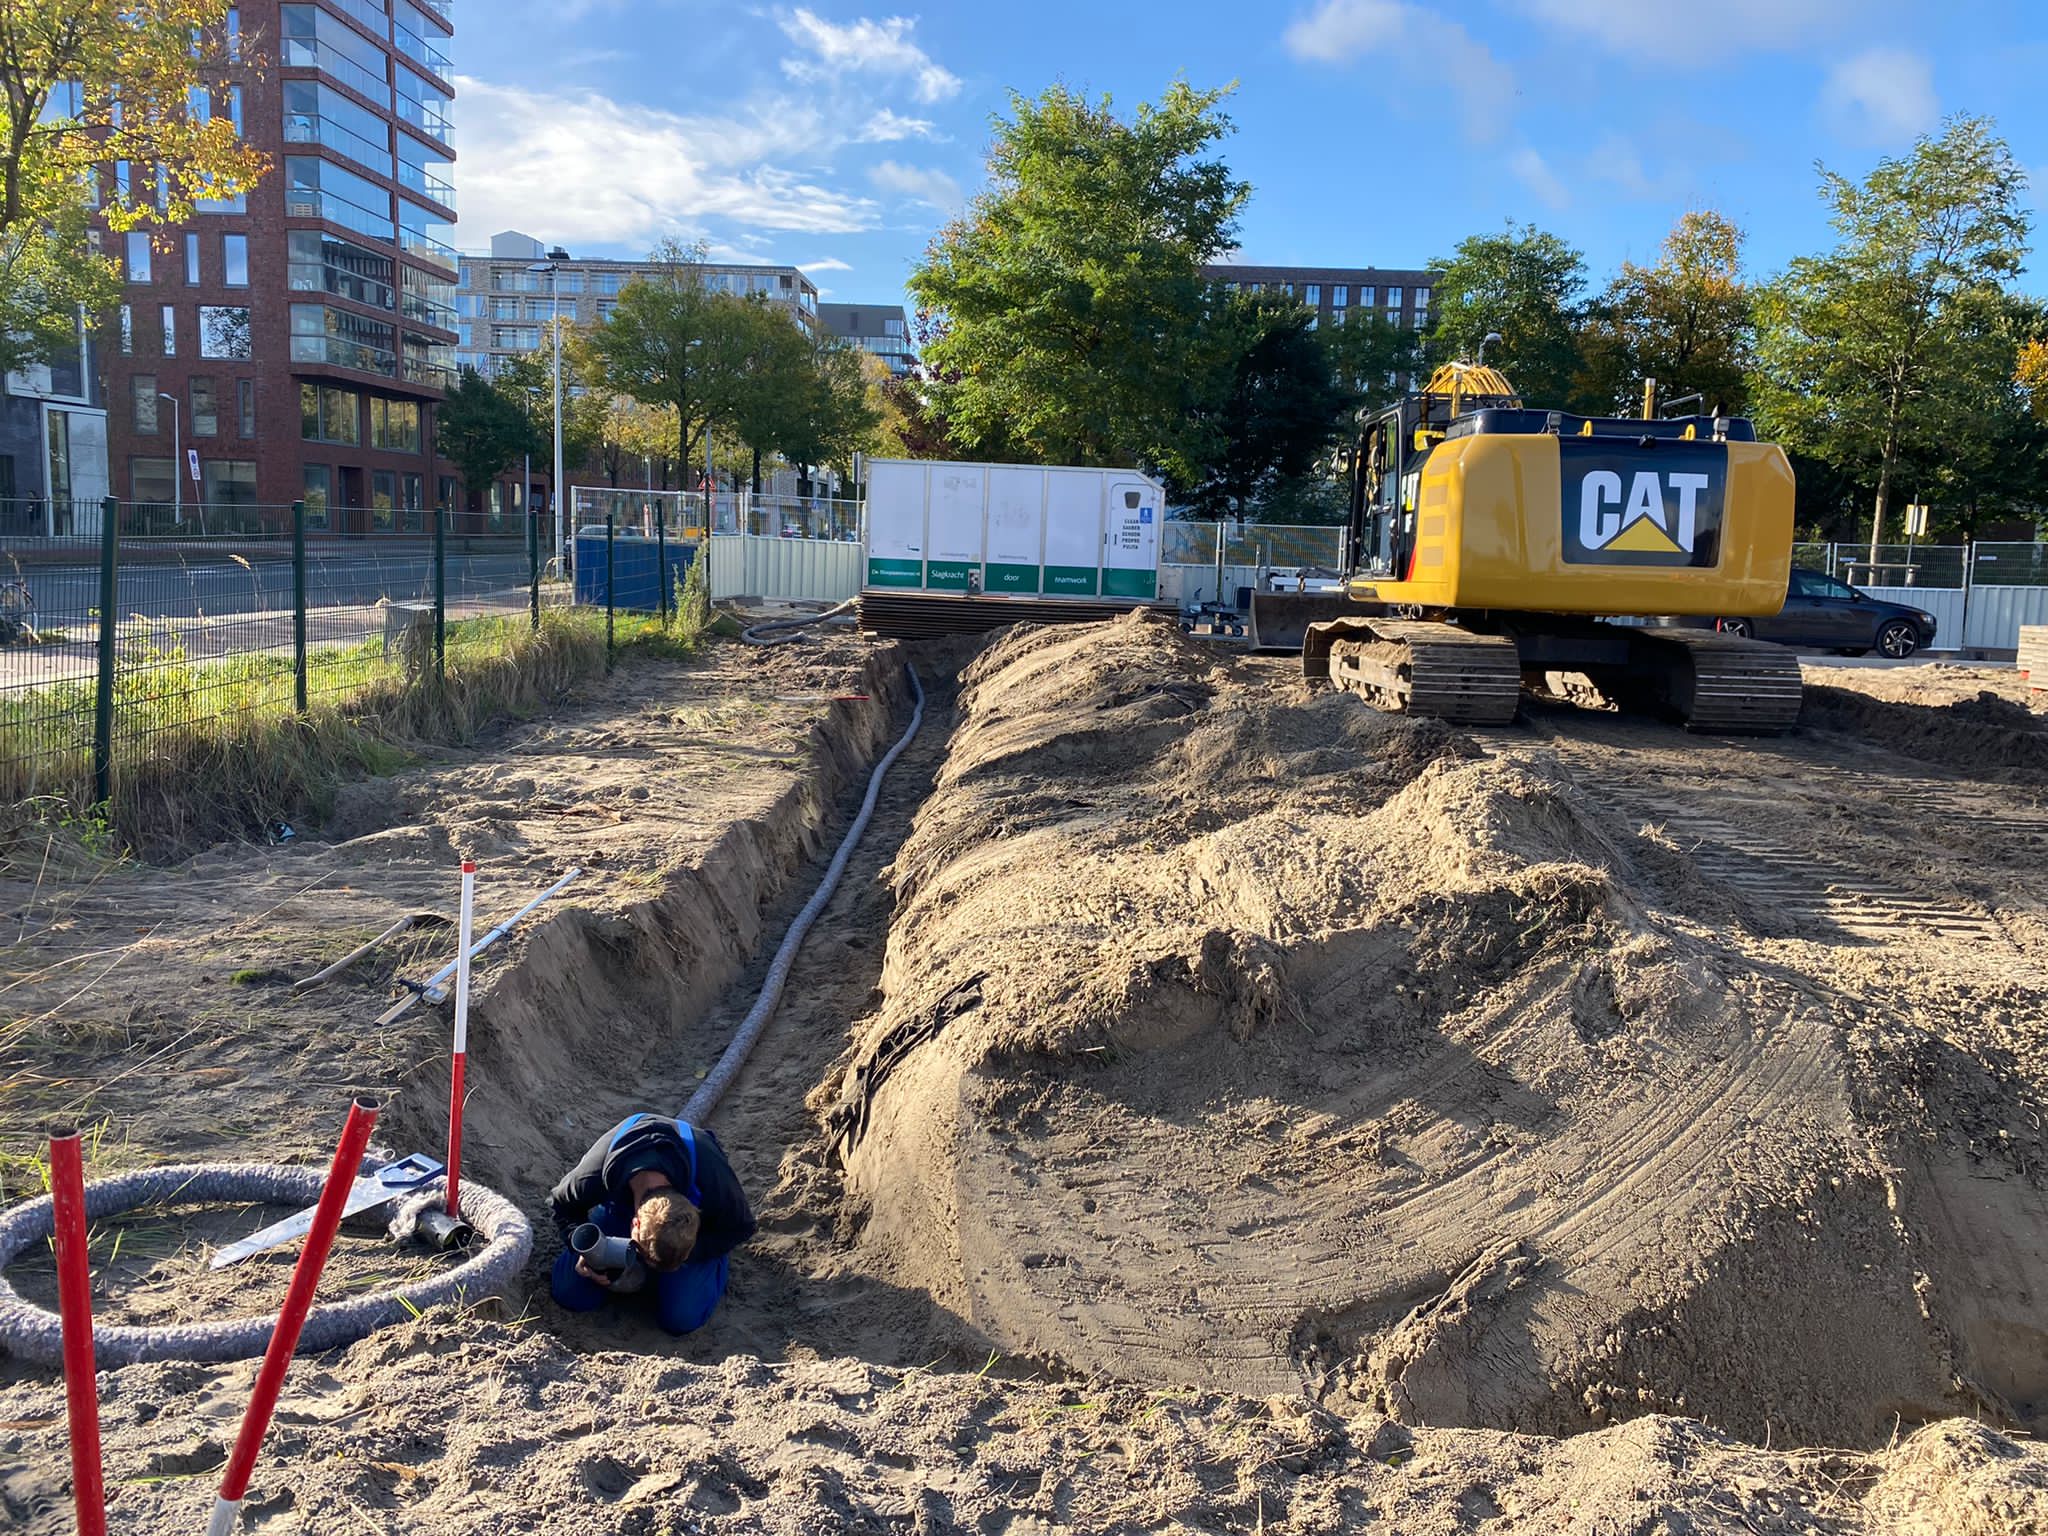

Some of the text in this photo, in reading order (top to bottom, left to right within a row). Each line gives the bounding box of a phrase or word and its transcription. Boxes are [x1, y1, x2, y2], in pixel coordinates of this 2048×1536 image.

[1579, 470, 1709, 553] CAT
[1003, 571, 1020, 581] door
[1054, 576, 1087, 584] teamwork
